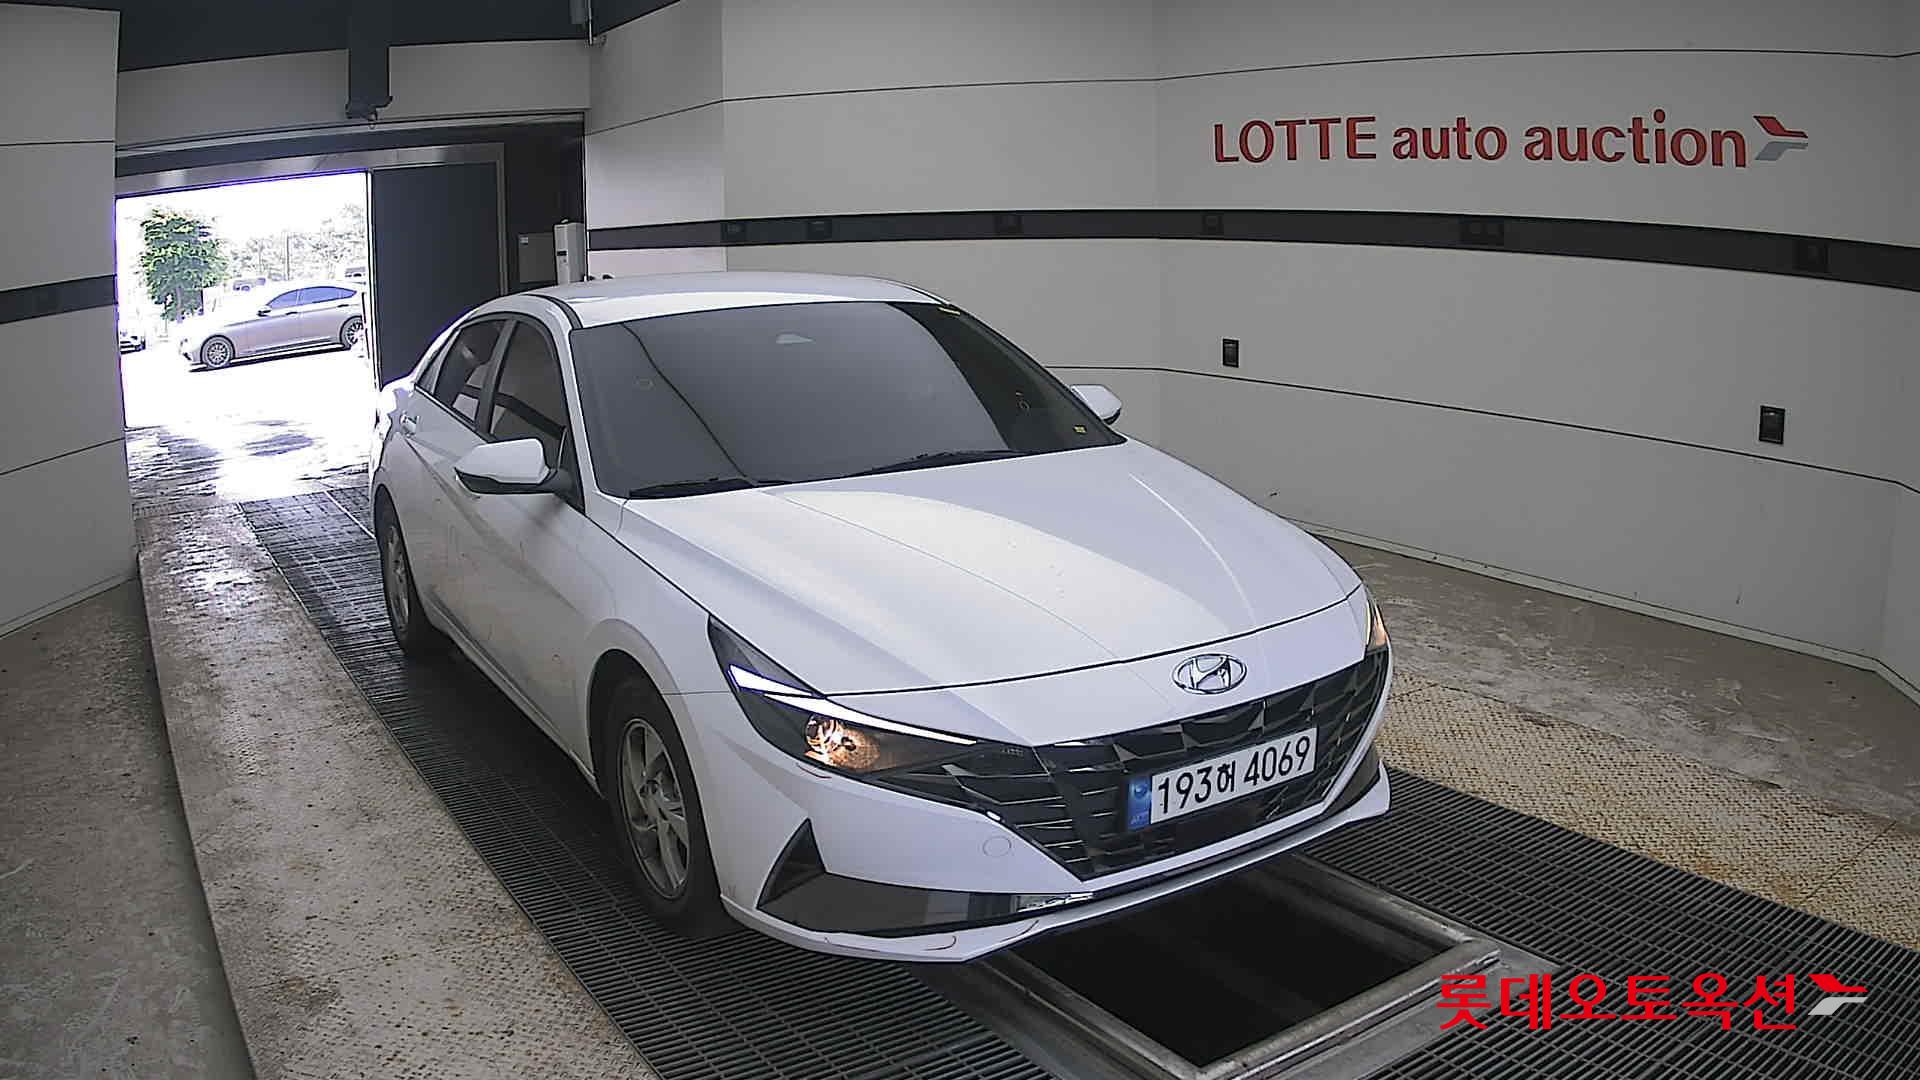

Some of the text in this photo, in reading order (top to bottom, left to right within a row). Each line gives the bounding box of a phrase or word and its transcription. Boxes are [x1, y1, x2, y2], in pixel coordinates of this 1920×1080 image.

[1214, 110, 1747, 168] LOTTE auto auction
[1158, 736, 1311, 815] 193허 4069
